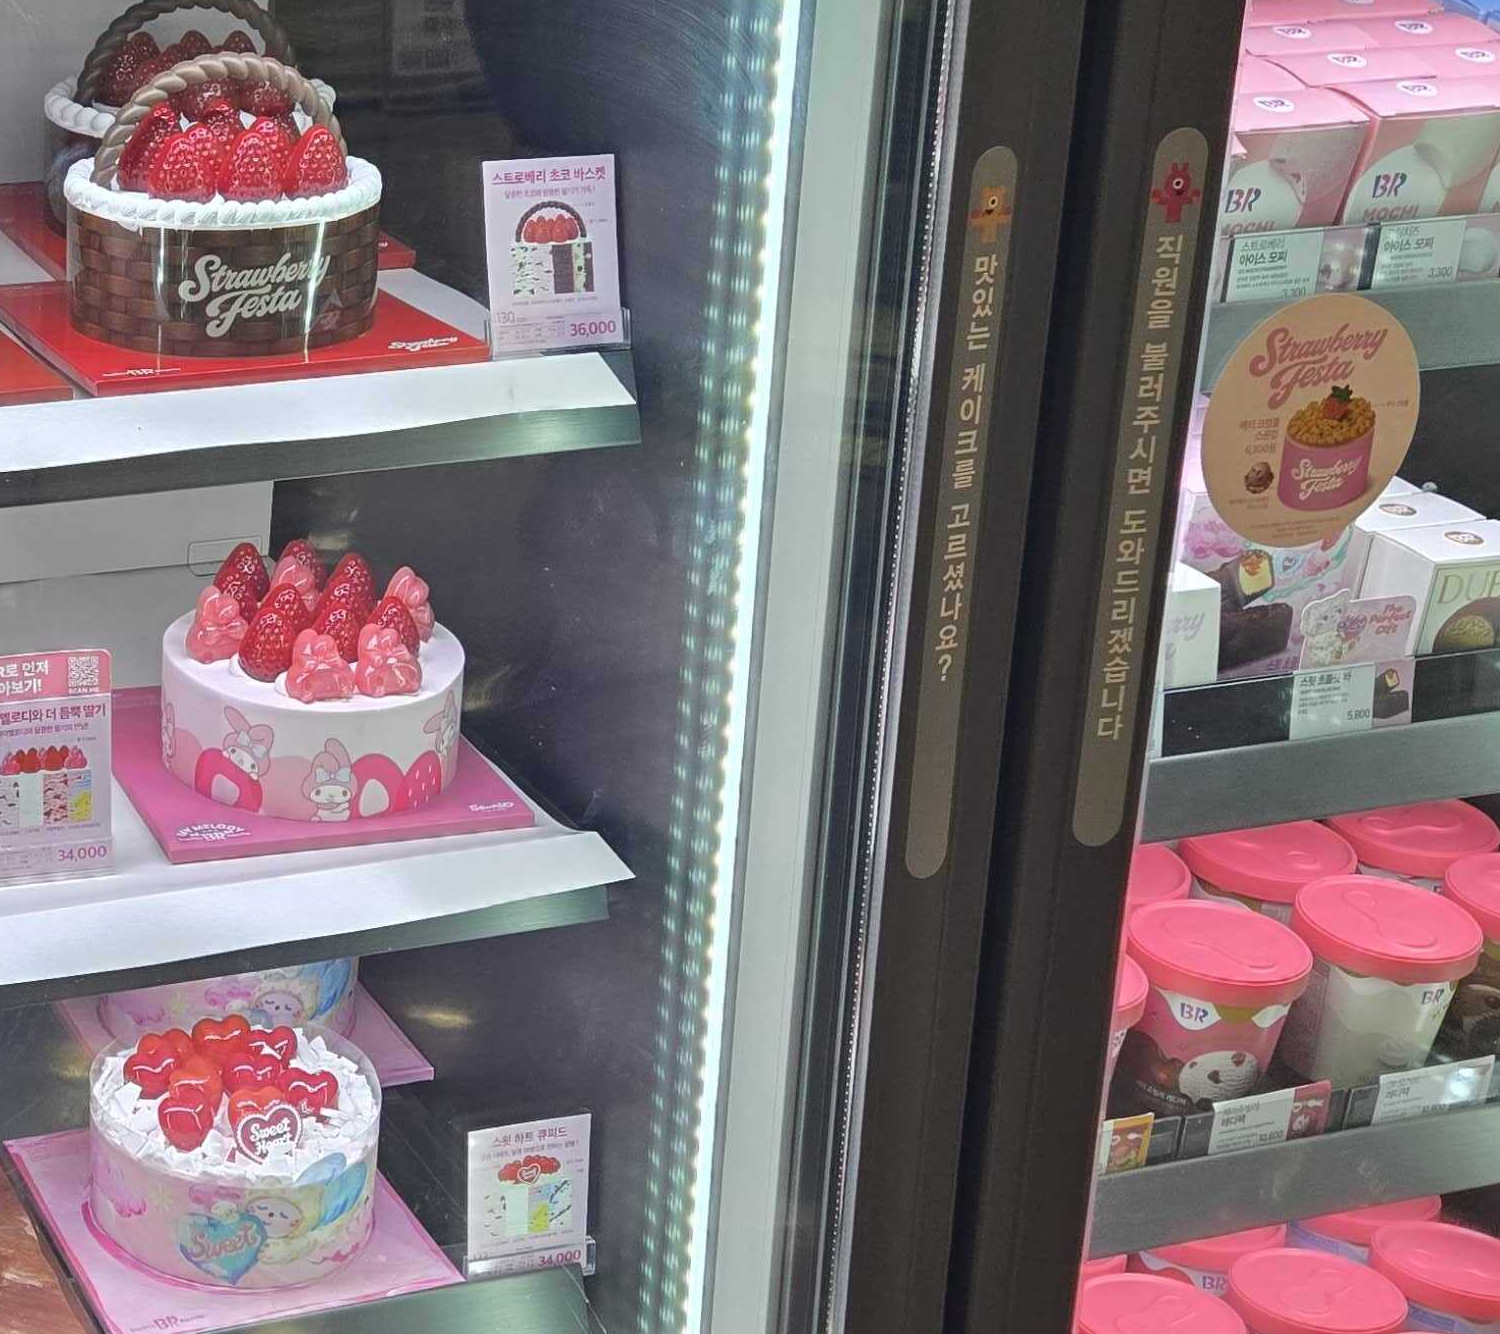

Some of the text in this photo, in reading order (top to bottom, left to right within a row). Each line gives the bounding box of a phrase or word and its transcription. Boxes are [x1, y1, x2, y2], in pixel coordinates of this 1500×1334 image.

[493, 166, 606, 186] 스트로베리 초코 바스켓
[1372, 172, 1407, 198] BR
[1224, 187, 1262, 213] BR
[1239, 251, 1265, 266] 아이스
[178, 252, 331, 302] Strawberry
[205, 286, 303, 337] Festa
[570, 320, 616, 338] 36,000
[1250, 323, 1388, 377] Strawberry
[1268, 355, 1353, 410] Festa
[935, 255, 998, 682] 맛있는 케이크를 고르셨나요?
[1096, 235, 1185, 740] 직원을 불러주시면 도와드리겠습니다
[1300, 478, 1343, 501] Festa
[22, 661, 49, 676] 먼저
[46, 708, 58, 721] 더
[83, 704, 106, 718] 딸기
[58, 845, 107, 862] 34,000
[1421, 988, 1445, 1005] BR
[1180, 1004, 1208, 1024] BR
[250, 1117, 291, 1142] Sweet
[515, 1132, 534, 1143] 하트
[538, 1127, 568, 1139] 큐피드
[191, 1224, 258, 1259] Sweet
[538, 1250, 581, 1267] 34,000
[1202, 1274, 1227, 1291] BR
[154, 1315, 180, 1330] BR
